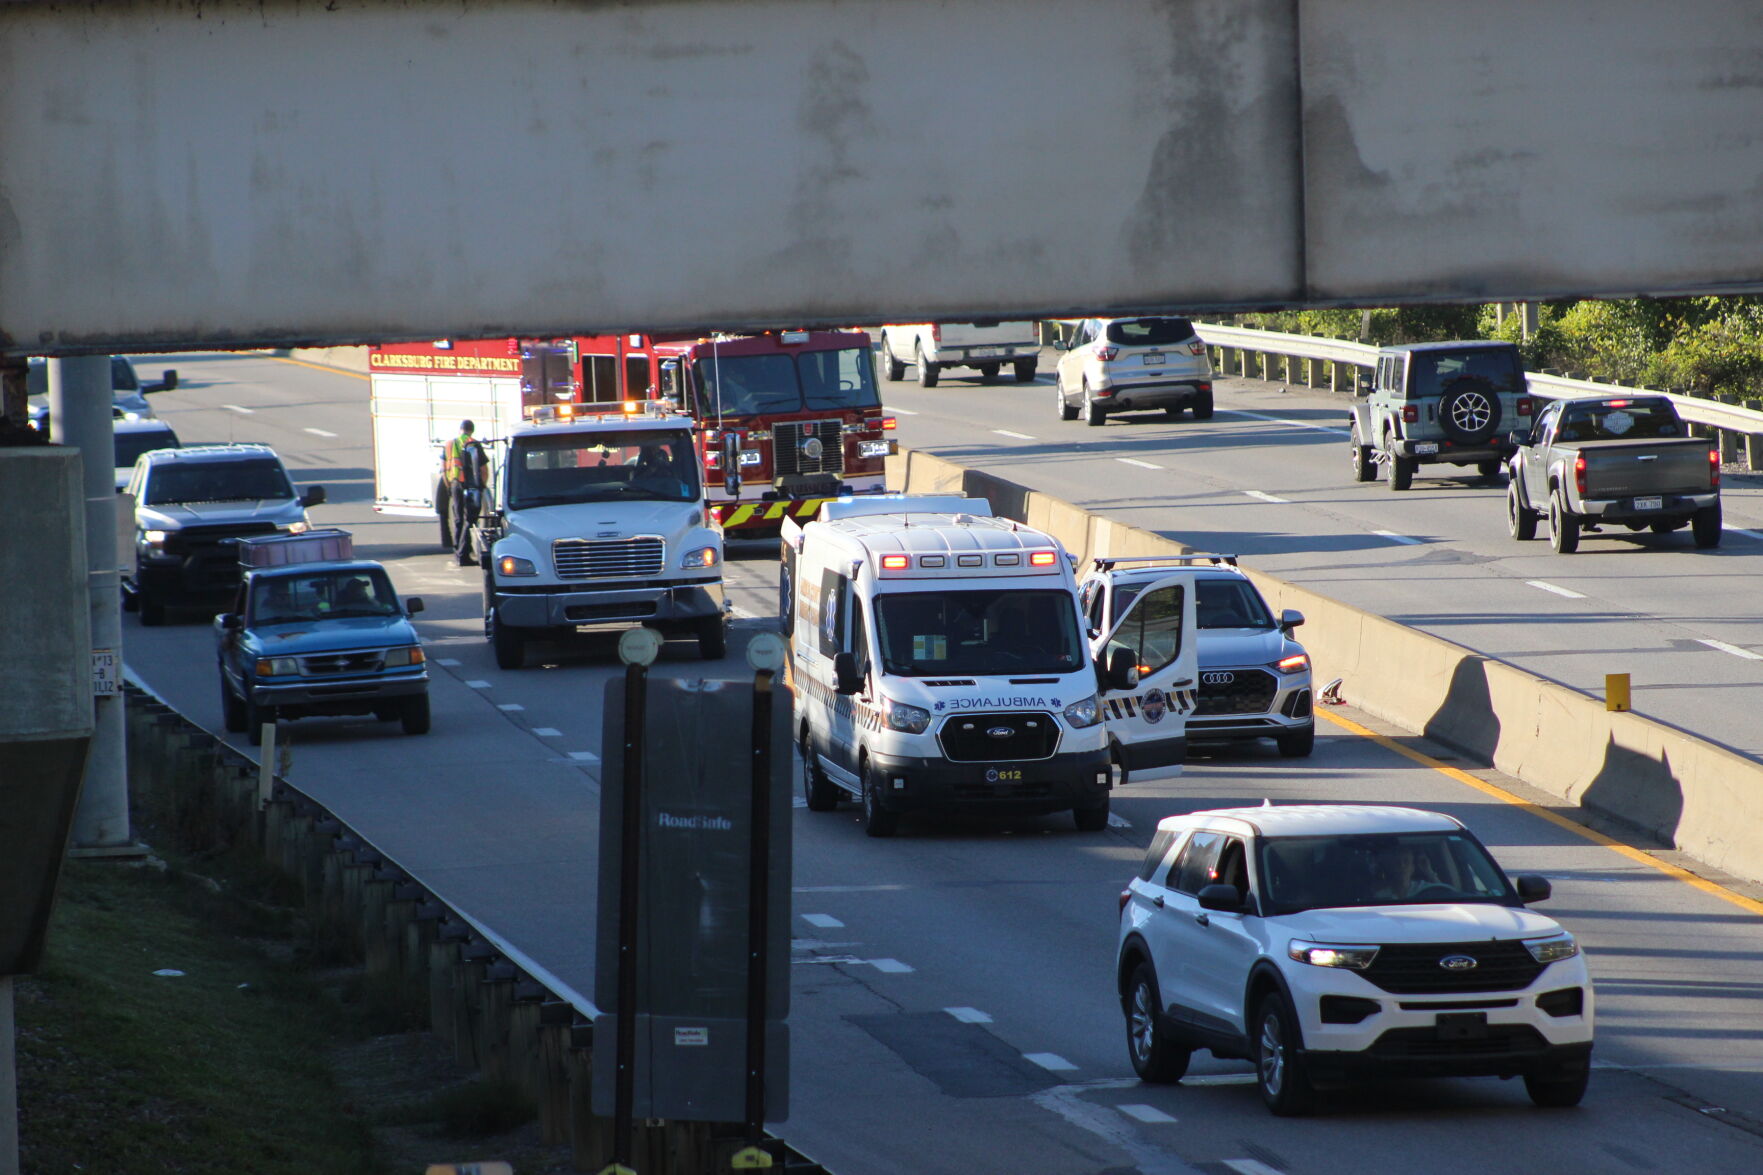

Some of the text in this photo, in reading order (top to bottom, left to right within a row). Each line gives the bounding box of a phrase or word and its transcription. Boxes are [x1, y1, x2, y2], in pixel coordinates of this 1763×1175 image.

[371, 353, 519, 371] CLARKSBURG FIRE DEPARTMENT
[998, 770, 1022, 780] 612
[658, 812, 732, 831] RoadSafe
